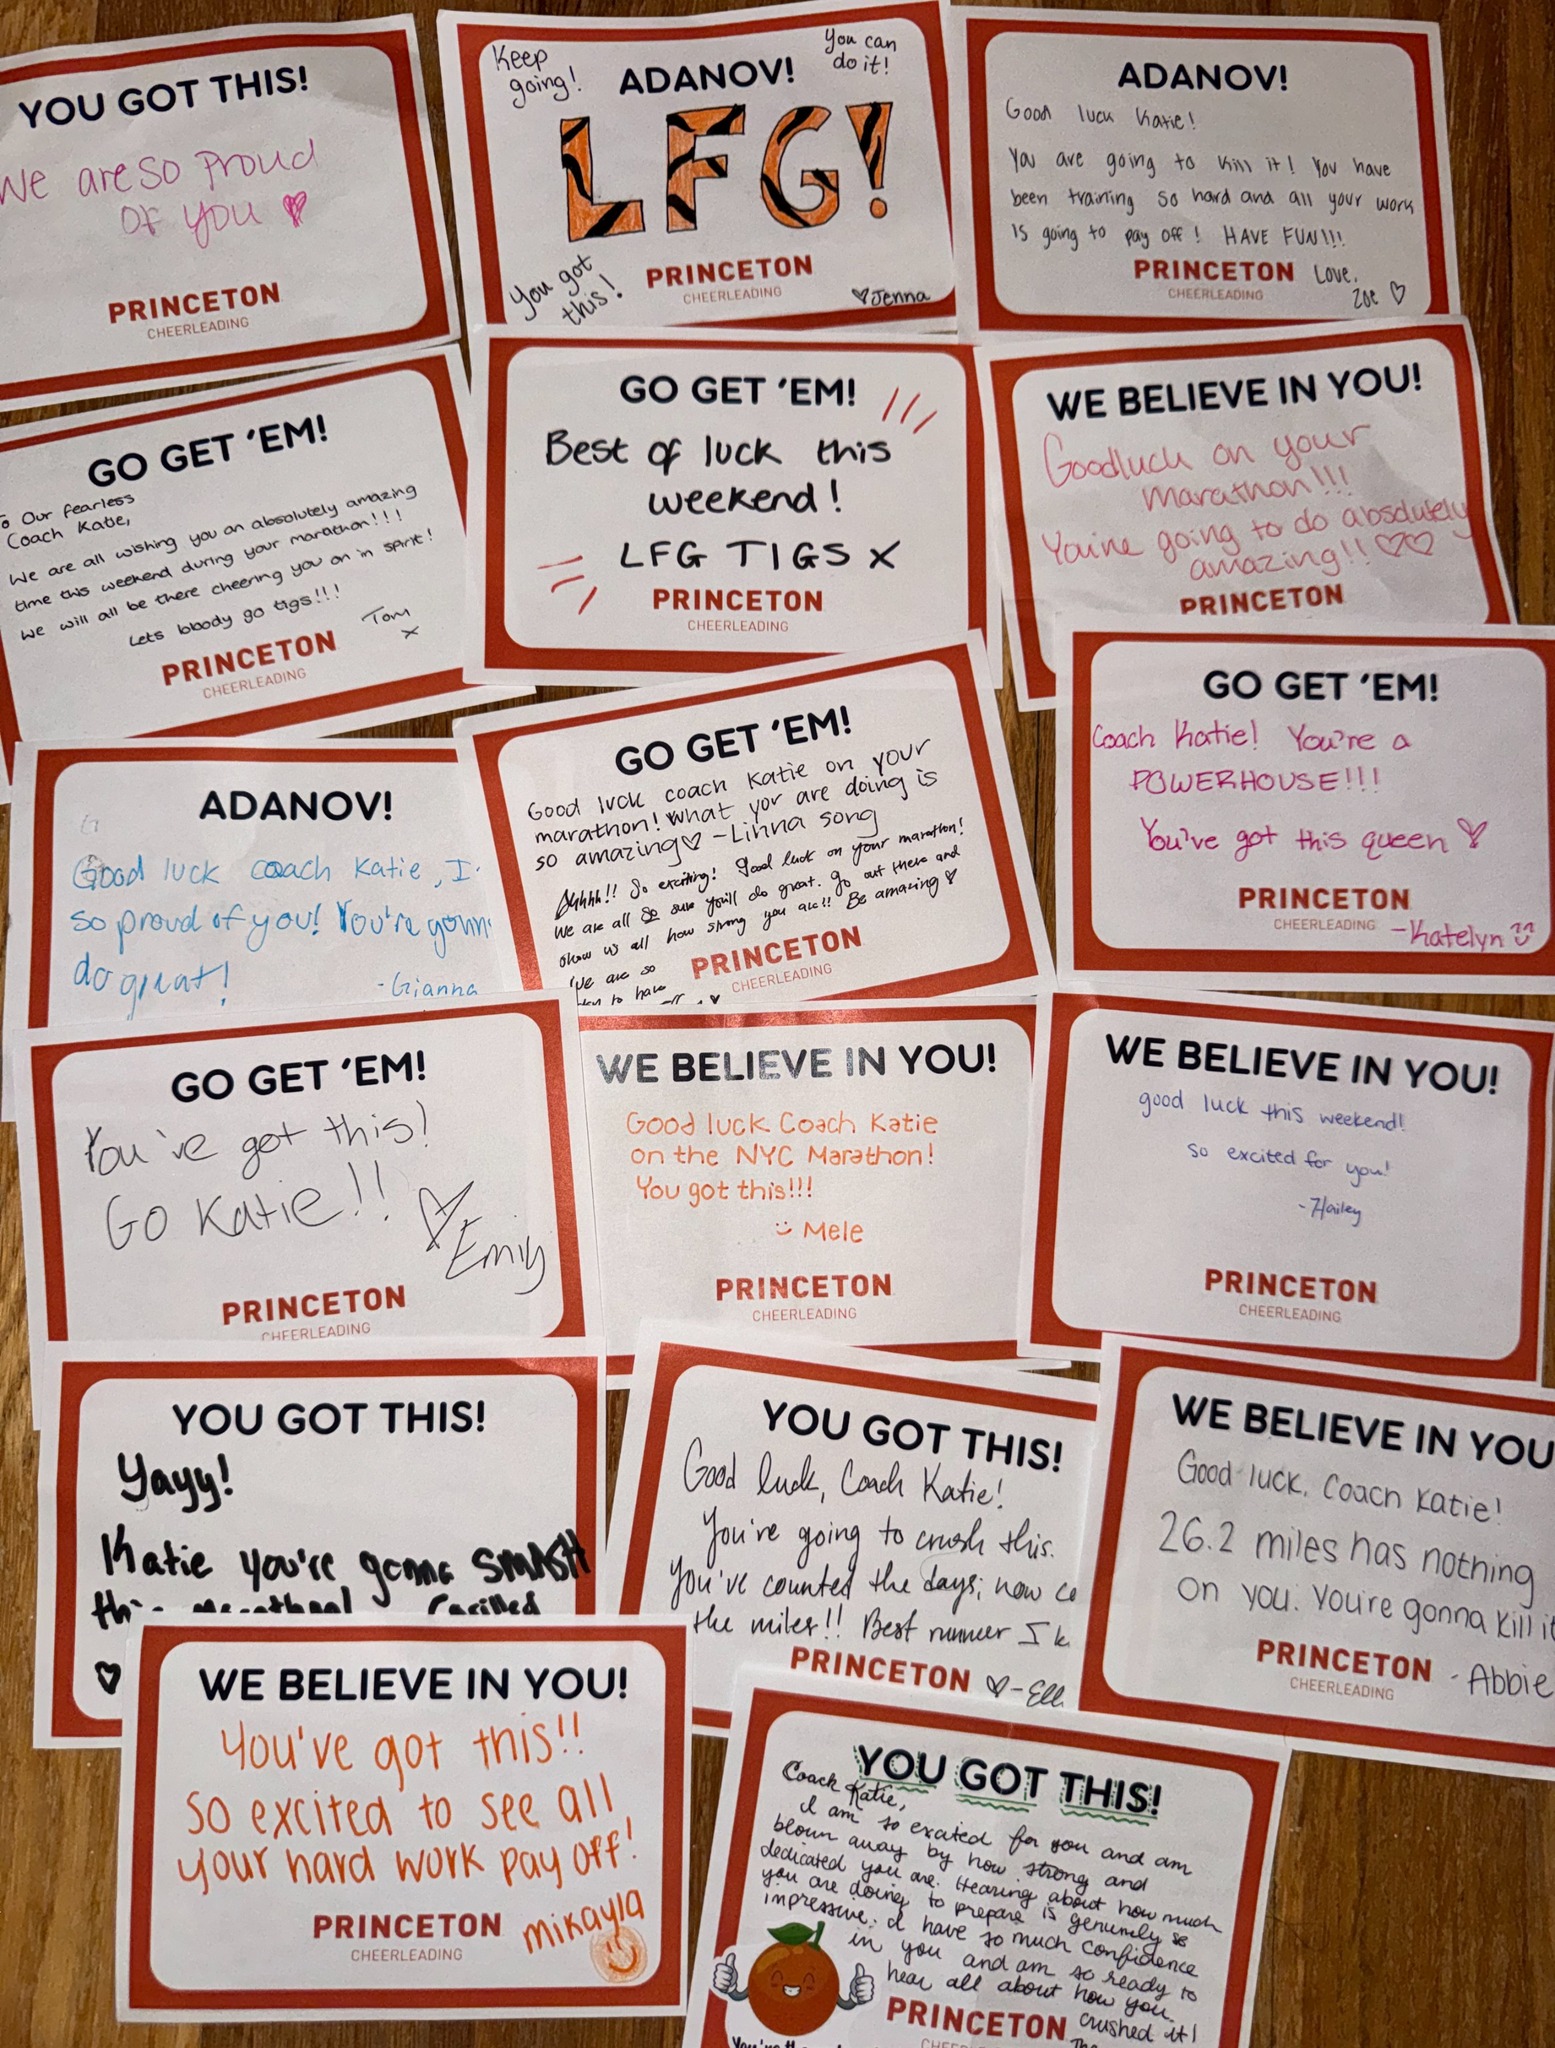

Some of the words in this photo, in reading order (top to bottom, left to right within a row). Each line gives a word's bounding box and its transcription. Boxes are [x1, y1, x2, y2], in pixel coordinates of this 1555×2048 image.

[494, 44, 548, 71] Keep
[864, 36, 897, 52] can
[619, 56, 794, 95] ADANOV!
[832, 56, 858, 70] do
[863, 53, 889, 75] it!
[1117, 62, 1287, 91] ADANOV!
[19, 93, 104, 128] YOU
[118, 79, 198, 115] GOT
[210, 66, 308, 102] THIS!
[510, 70, 581, 108] going!
[78, 165, 133, 197] are
[560, 101, 893, 242] LFG!
[1106, 152, 1155, 179] going
[1354, 158, 1390, 178] have
[1012, 189, 1048, 206] been
[183, 201, 262, 249] you
[1225, 228, 1268, 246] HAVE
[1283, 228, 1346, 248] FUN!!!
[558, 254, 593, 295] got
[646, 254, 813, 289] PRINCETON
[1134, 259, 1294, 282] PRINCETON
[108, 282, 280, 323] PRINCETON
[562, 273, 622, 326] this!
[683, 286, 781, 305] CHEERLEADING
[871, 289, 931, 306] Jenna
[1168, 287, 1264, 301] CHEERLEADING
[147, 317, 249, 340] CHEERLEADING
[620, 375, 678, 404] GO
[692, 376, 766, 405] GET
[778, 378, 856, 406] 'EM!
[1047, 389, 1106, 421] WE
[1118, 378, 1268, 416] BELIEVE
[1279, 374, 1316, 404] IN
[1327, 362, 1422, 399] YOU!
[88, 452, 147, 487] GO
[160, 432, 234, 472] GET
[247, 415, 328, 454] 'EM!
[546, 430, 629, 466] Best
[648, 437, 682, 475] of
[706, 435, 782, 466] luck
[817, 439, 891, 464] this
[63, 493, 136, 519] fearless
[649, 480, 842, 515] weekend!
[115, 534, 178, 562] wishing
[251, 502, 339, 529] absolutely
[346, 483, 417, 509] amazing
[1157, 522, 1239, 563] going
[1294, 510, 1328, 533] do
[101, 566, 172, 591] weekend
[181, 549, 234, 574] during
[620, 541, 707, 569] LFG
[726, 541, 850, 570] TIGS
[211, 569, 283, 594] cheering
[653, 588, 823, 611] PRINCETON
[1180, 583, 1344, 616] PRINCETON
[688, 619, 788, 632] CHEERLEADING
[162, 630, 336, 685] PRINCETON
[202, 667, 307, 699] CHEERLEADING
[1203, 670, 1261, 700] GO
[1275, 671, 1349, 700] GET
[1360, 674, 1438, 701] 'EM!
[615, 740, 674, 776] GO
[687, 723, 759, 764] GET
[771, 705, 851, 746] 'EM!
[1175, 720, 1258, 750] Katie!
[1288, 724, 1375, 752] You're
[665, 780, 727, 803] coach
[797, 786, 828, 804] are
[845, 774, 908, 800] doing
[1129, 766, 1380, 794] POWERHOUSE!!!
[199, 790, 392, 821] ADANOV!
[575, 838, 682, 868] amazing
[1235, 824, 1278, 861] got
[1294, 828, 1347, 851] this
[1361, 831, 1448, 859] queen
[164, 856, 220, 885] luck
[1239, 888, 1410, 910] PRINCETON
[117, 904, 201, 954] proud
[1274, 918, 1375, 931] CHEERLEADING
[691, 925, 862, 979] PRINCETON
[732, 961, 832, 993] CHEERLEADING
[172, 1069, 234, 1102] GO
[248, 1059, 329, 1094] GET
[342, 1050, 426, 1087] 'EM!
[596, 1053, 659, 1084] WE
[672, 1048, 831, 1082] BELIEVE
[846, 1046, 885, 1076] IN
[899, 1043, 996, 1074] YOU!
[1106, 1033, 1164, 1067] WE
[1178, 1041, 1341, 1083] BELIEVE
[1351, 1055, 1391, 1086] IN
[1404, 1059, 1498, 1095] YOU!
[708, 1112, 770, 1135] luck
[779, 1112, 856, 1134] Coach
[871, 1111, 939, 1134] Katie
[1139, 1090, 1184, 1117] good
[1204, 1094, 1248, 1114] luck
[1261, 1103, 1304, 1124] this
[241, 1121, 308, 1179] got
[324, 1100, 429, 1148] this!
[674, 1145, 718, 1166] the
[736, 1144, 794, 1166] NYC
[808, 1143, 934, 1166] Marathon!
[1227, 1146, 1295, 1165] excited
[636, 1176, 680, 1200] You
[688, 1179, 729, 1207] got
[716, 1273, 892, 1301] PRINCETON
[1205, 1268, 1376, 1303] PRINCETON
[221, 1285, 405, 1325] PRINCETON
[752, 1307, 857, 1322] CHEERLEADING
[1239, 1304, 1341, 1322] CHEERLEADING
[172, 1403, 263, 1435] YOU
[277, 1403, 367, 1434] GOT
[381, 1400, 485, 1433] THIS!
[1173, 1393, 1233, 1430] WE
[1244, 1402, 1404, 1451] BELIEVE
[1416, 1424, 1456, 1457] IN
[1472, 1430, 1554, 1469] YOU
[763, 1399, 850, 1437] YOU
[863, 1414, 950, 1454] GOT
[961, 1427, 1062, 1473] THIS!
[118, 1452, 234, 1512] Yayy!
[683, 1437, 736, 1492] Good
[924, 1463, 1004, 1509] Katie!
[798, 1522, 860, 1568] going
[879, 1516, 904, 1545] to
[1159, 1510, 1234, 1554] 26.2
[1255, 1528, 1338, 1564] miles
[1350, 1532, 1406, 1570] has
[1422, 1549, 1534, 1609] nothing
[791, 1646, 970, 1693] PRINCETON
[1257, 1639, 1431, 1682] PRINCETON
[200, 1668, 265, 1700] WE
[279, 1668, 453, 1700] BELIEVE
[467, 1668, 509, 1699] IN
[524, 1667, 627, 1699] YOU!
[1290, 1677, 1394, 1700] CHEERLEADING
[374, 1733, 443, 1792] got
[473, 1711, 584, 1772] this!!
[853, 1744, 946, 1785] YOU
[954, 1757, 1049, 1801] GOT
[1060, 1769, 1162, 1816] THIS!
[419, 1792, 452, 1829] to
[481, 1790, 540, 1831] see
[558, 1773, 613, 1824] all
[1023, 1861, 1089, 1890] strong
[313, 1913, 501, 1939] PRINCETON
[350, 1948, 462, 1962] CHEERLEADING
[887, 1996, 1067, 2042] PRINCETON
